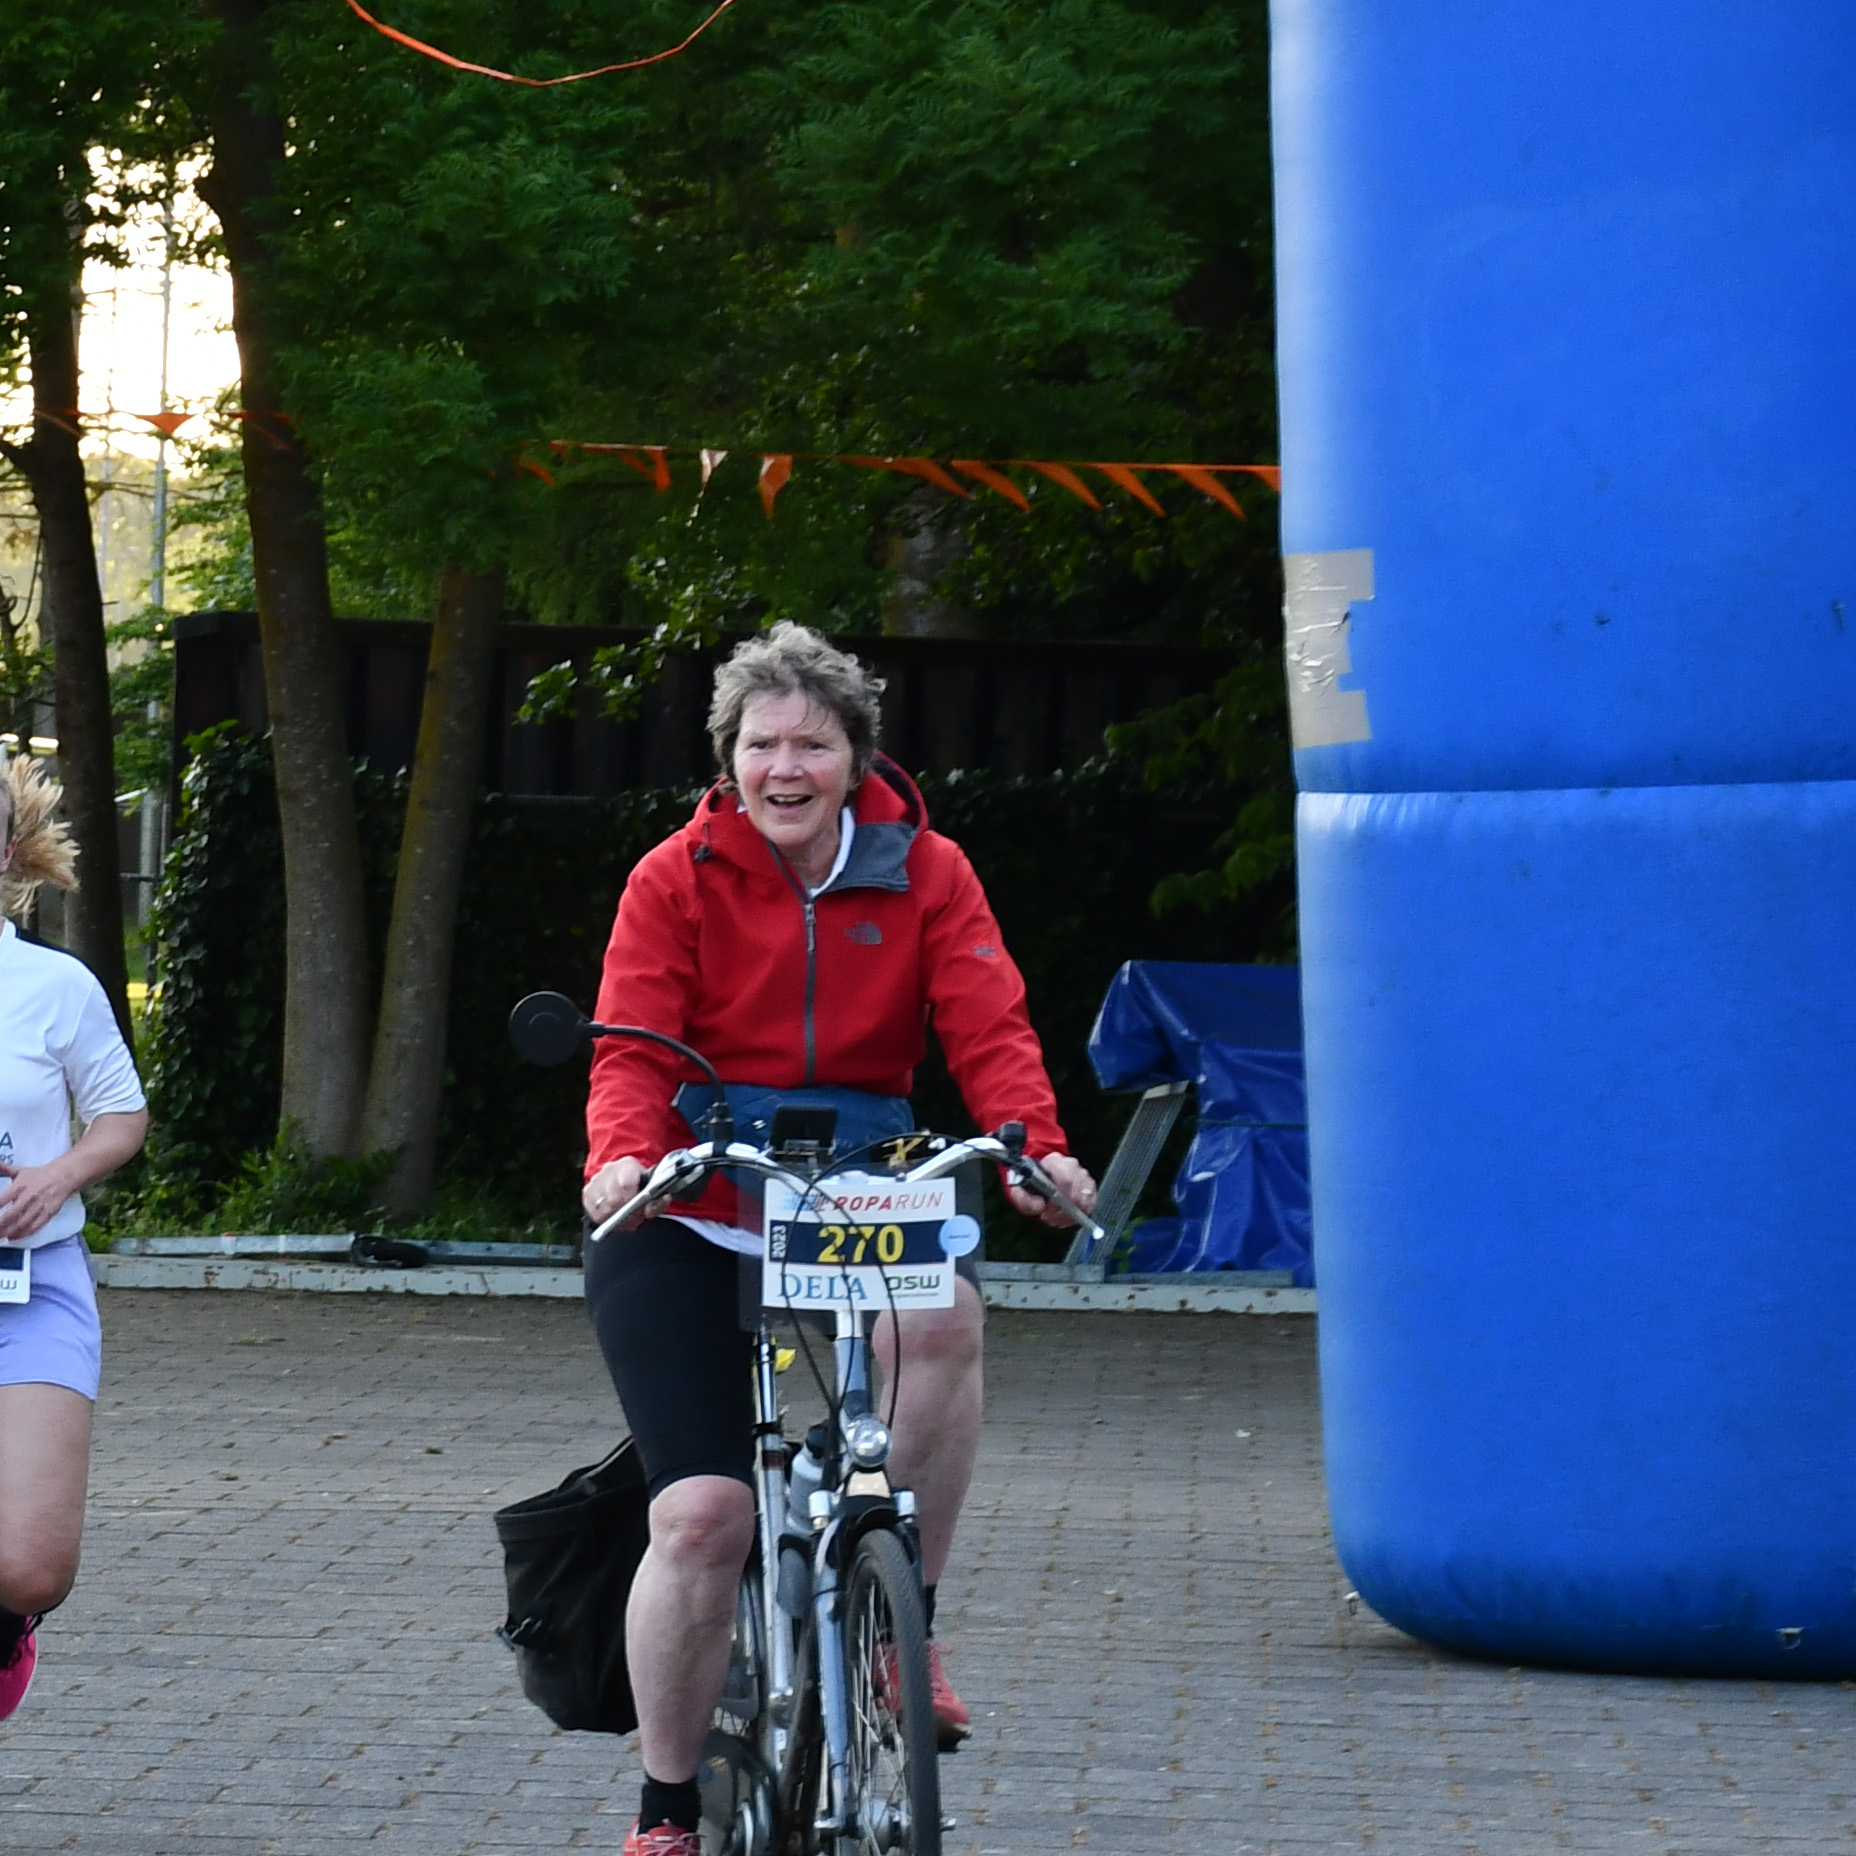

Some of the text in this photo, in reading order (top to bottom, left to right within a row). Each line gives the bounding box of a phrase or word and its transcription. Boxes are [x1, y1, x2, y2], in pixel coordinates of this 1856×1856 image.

[833, 1192, 944, 1212] ROPARUN
[771, 1225, 787, 1259] 2023
[816, 1224, 905, 1264] 270
[778, 1273, 941, 1300] DELA DSW
